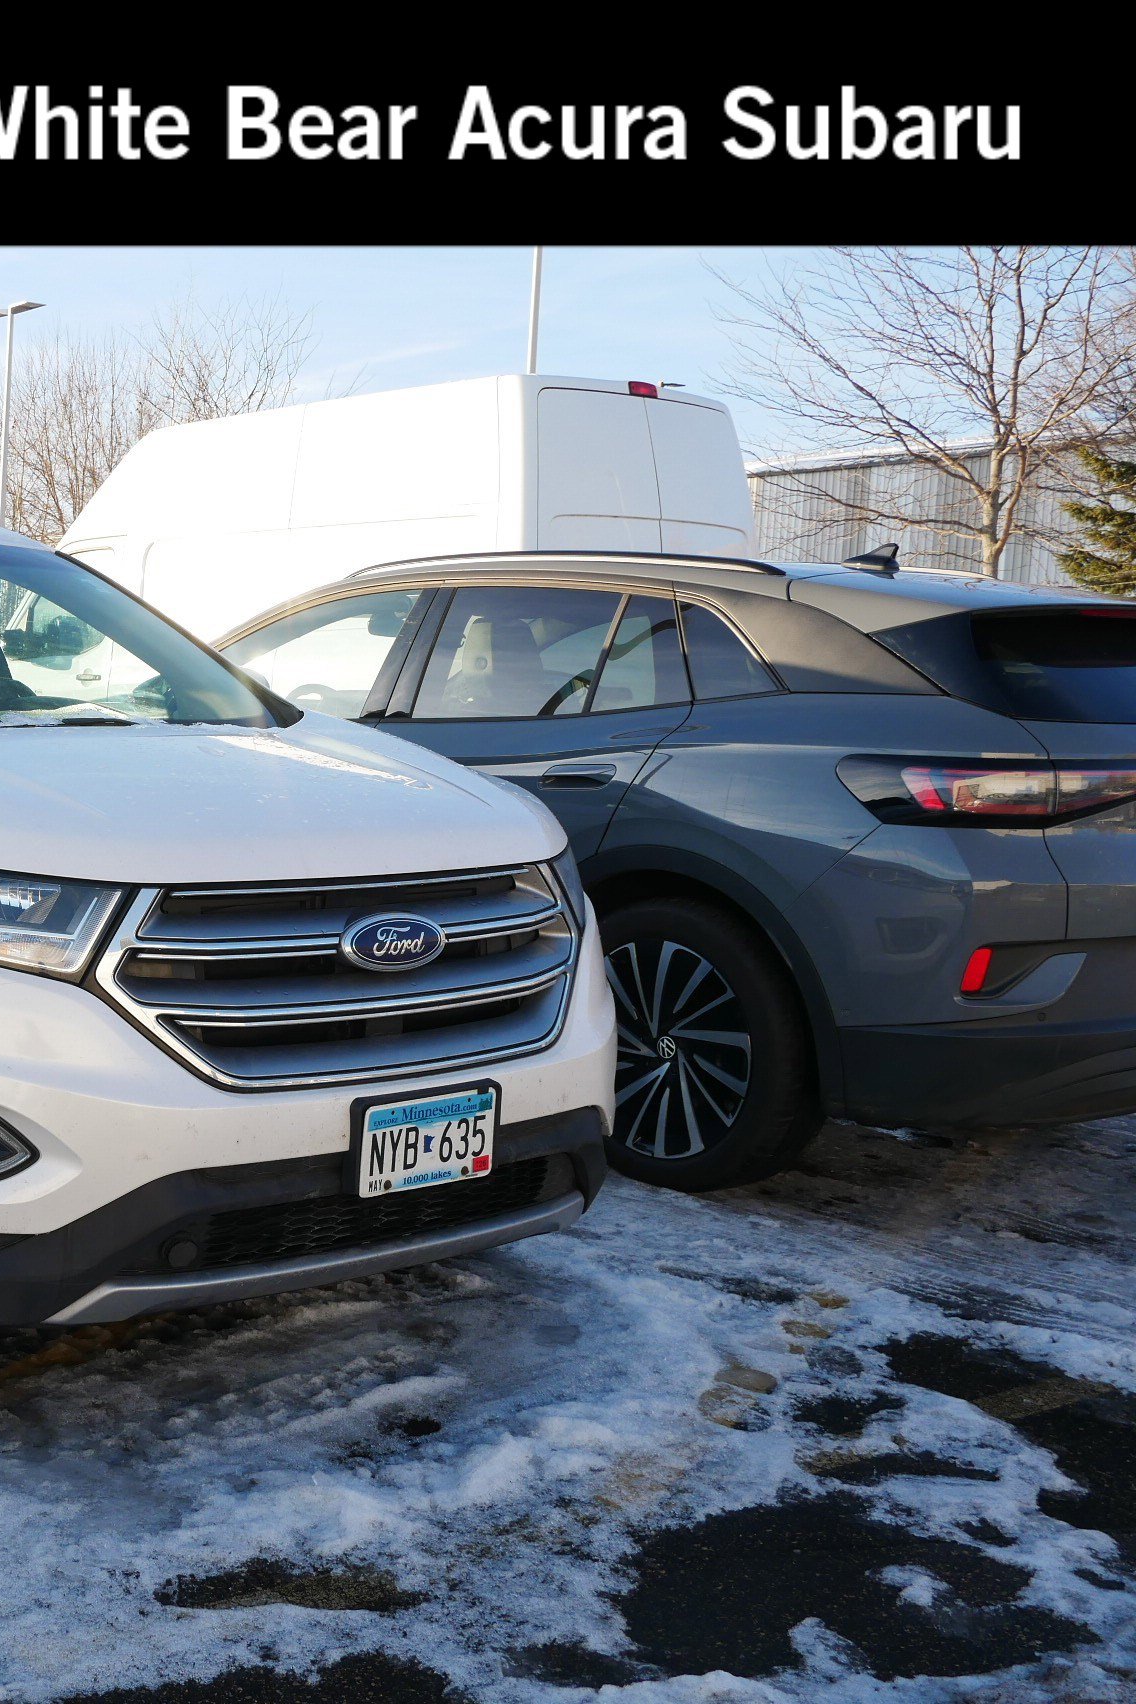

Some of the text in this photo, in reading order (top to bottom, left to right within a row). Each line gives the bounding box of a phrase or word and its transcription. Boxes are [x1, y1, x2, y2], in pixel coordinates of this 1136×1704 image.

[373, 926, 425, 957] Ford
[373, 1117, 398, 1127] EXPLORE
[369, 1115, 486, 1177] NYB 635
[402, 1173, 429, 1185] 10,000
[431, 1169, 452, 1180] lakes
[368, 1179, 383, 1192] MAY
